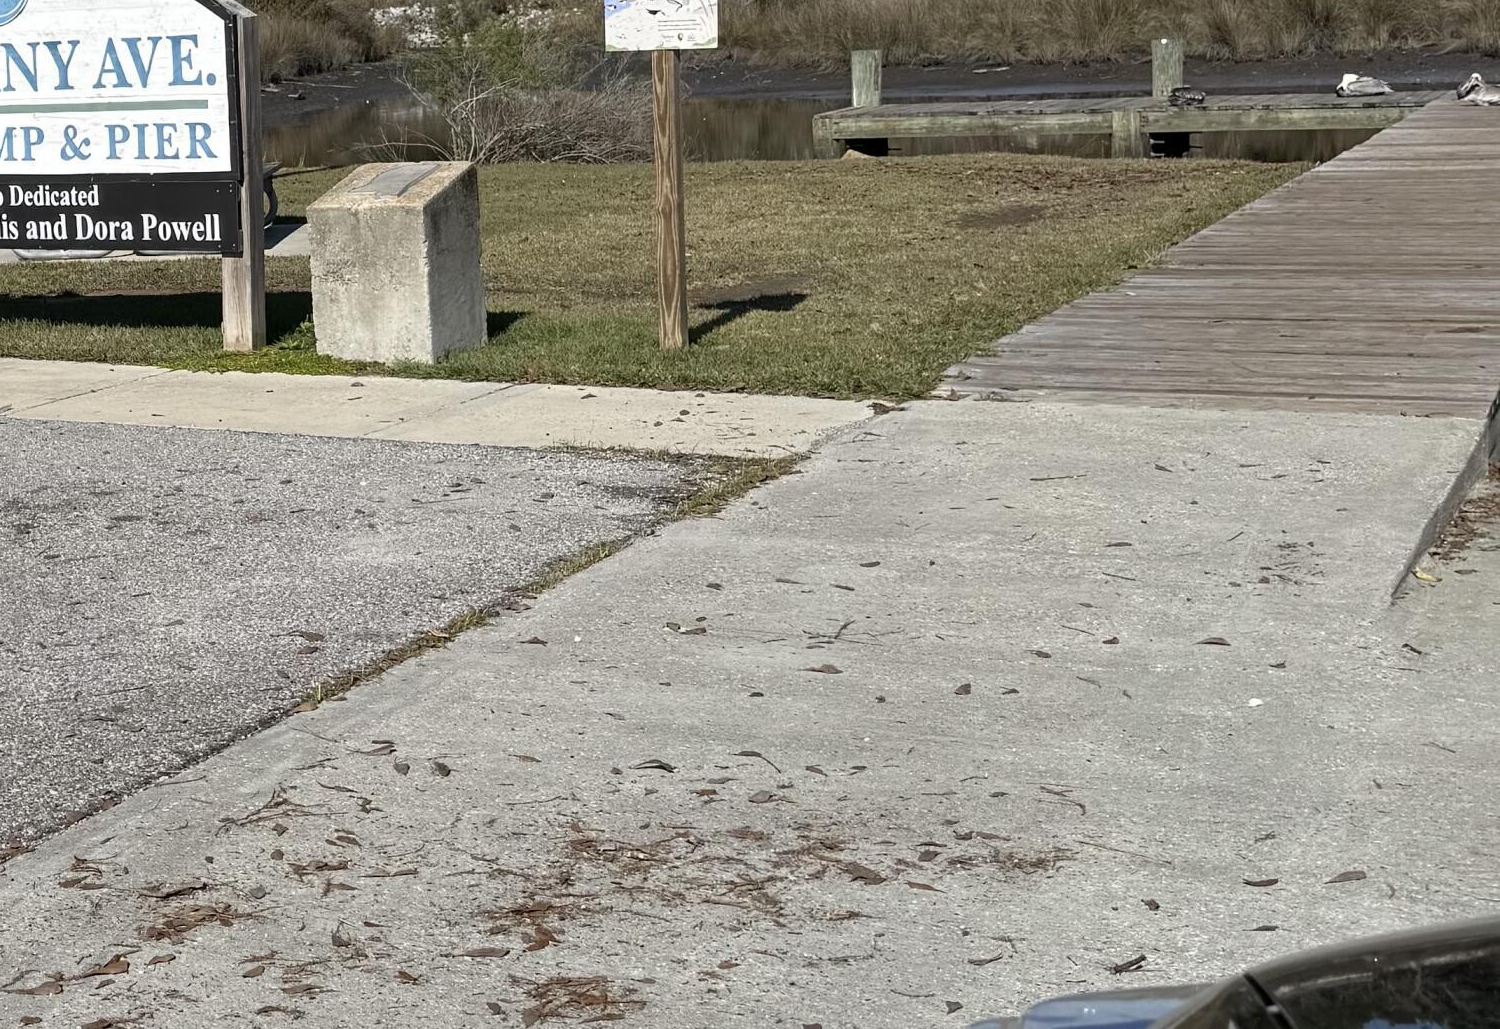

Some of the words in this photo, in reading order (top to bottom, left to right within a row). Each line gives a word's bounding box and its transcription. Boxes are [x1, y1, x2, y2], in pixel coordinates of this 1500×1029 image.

[93, 34, 217, 89] AVE.
[61, 124, 92, 161] &
[105, 122, 218, 161] PIER
[9, 185, 100, 207] Dedicated
[26, 214, 68, 240] and
[74, 214, 134, 241] Dora
[141, 214, 222, 242] Powell
